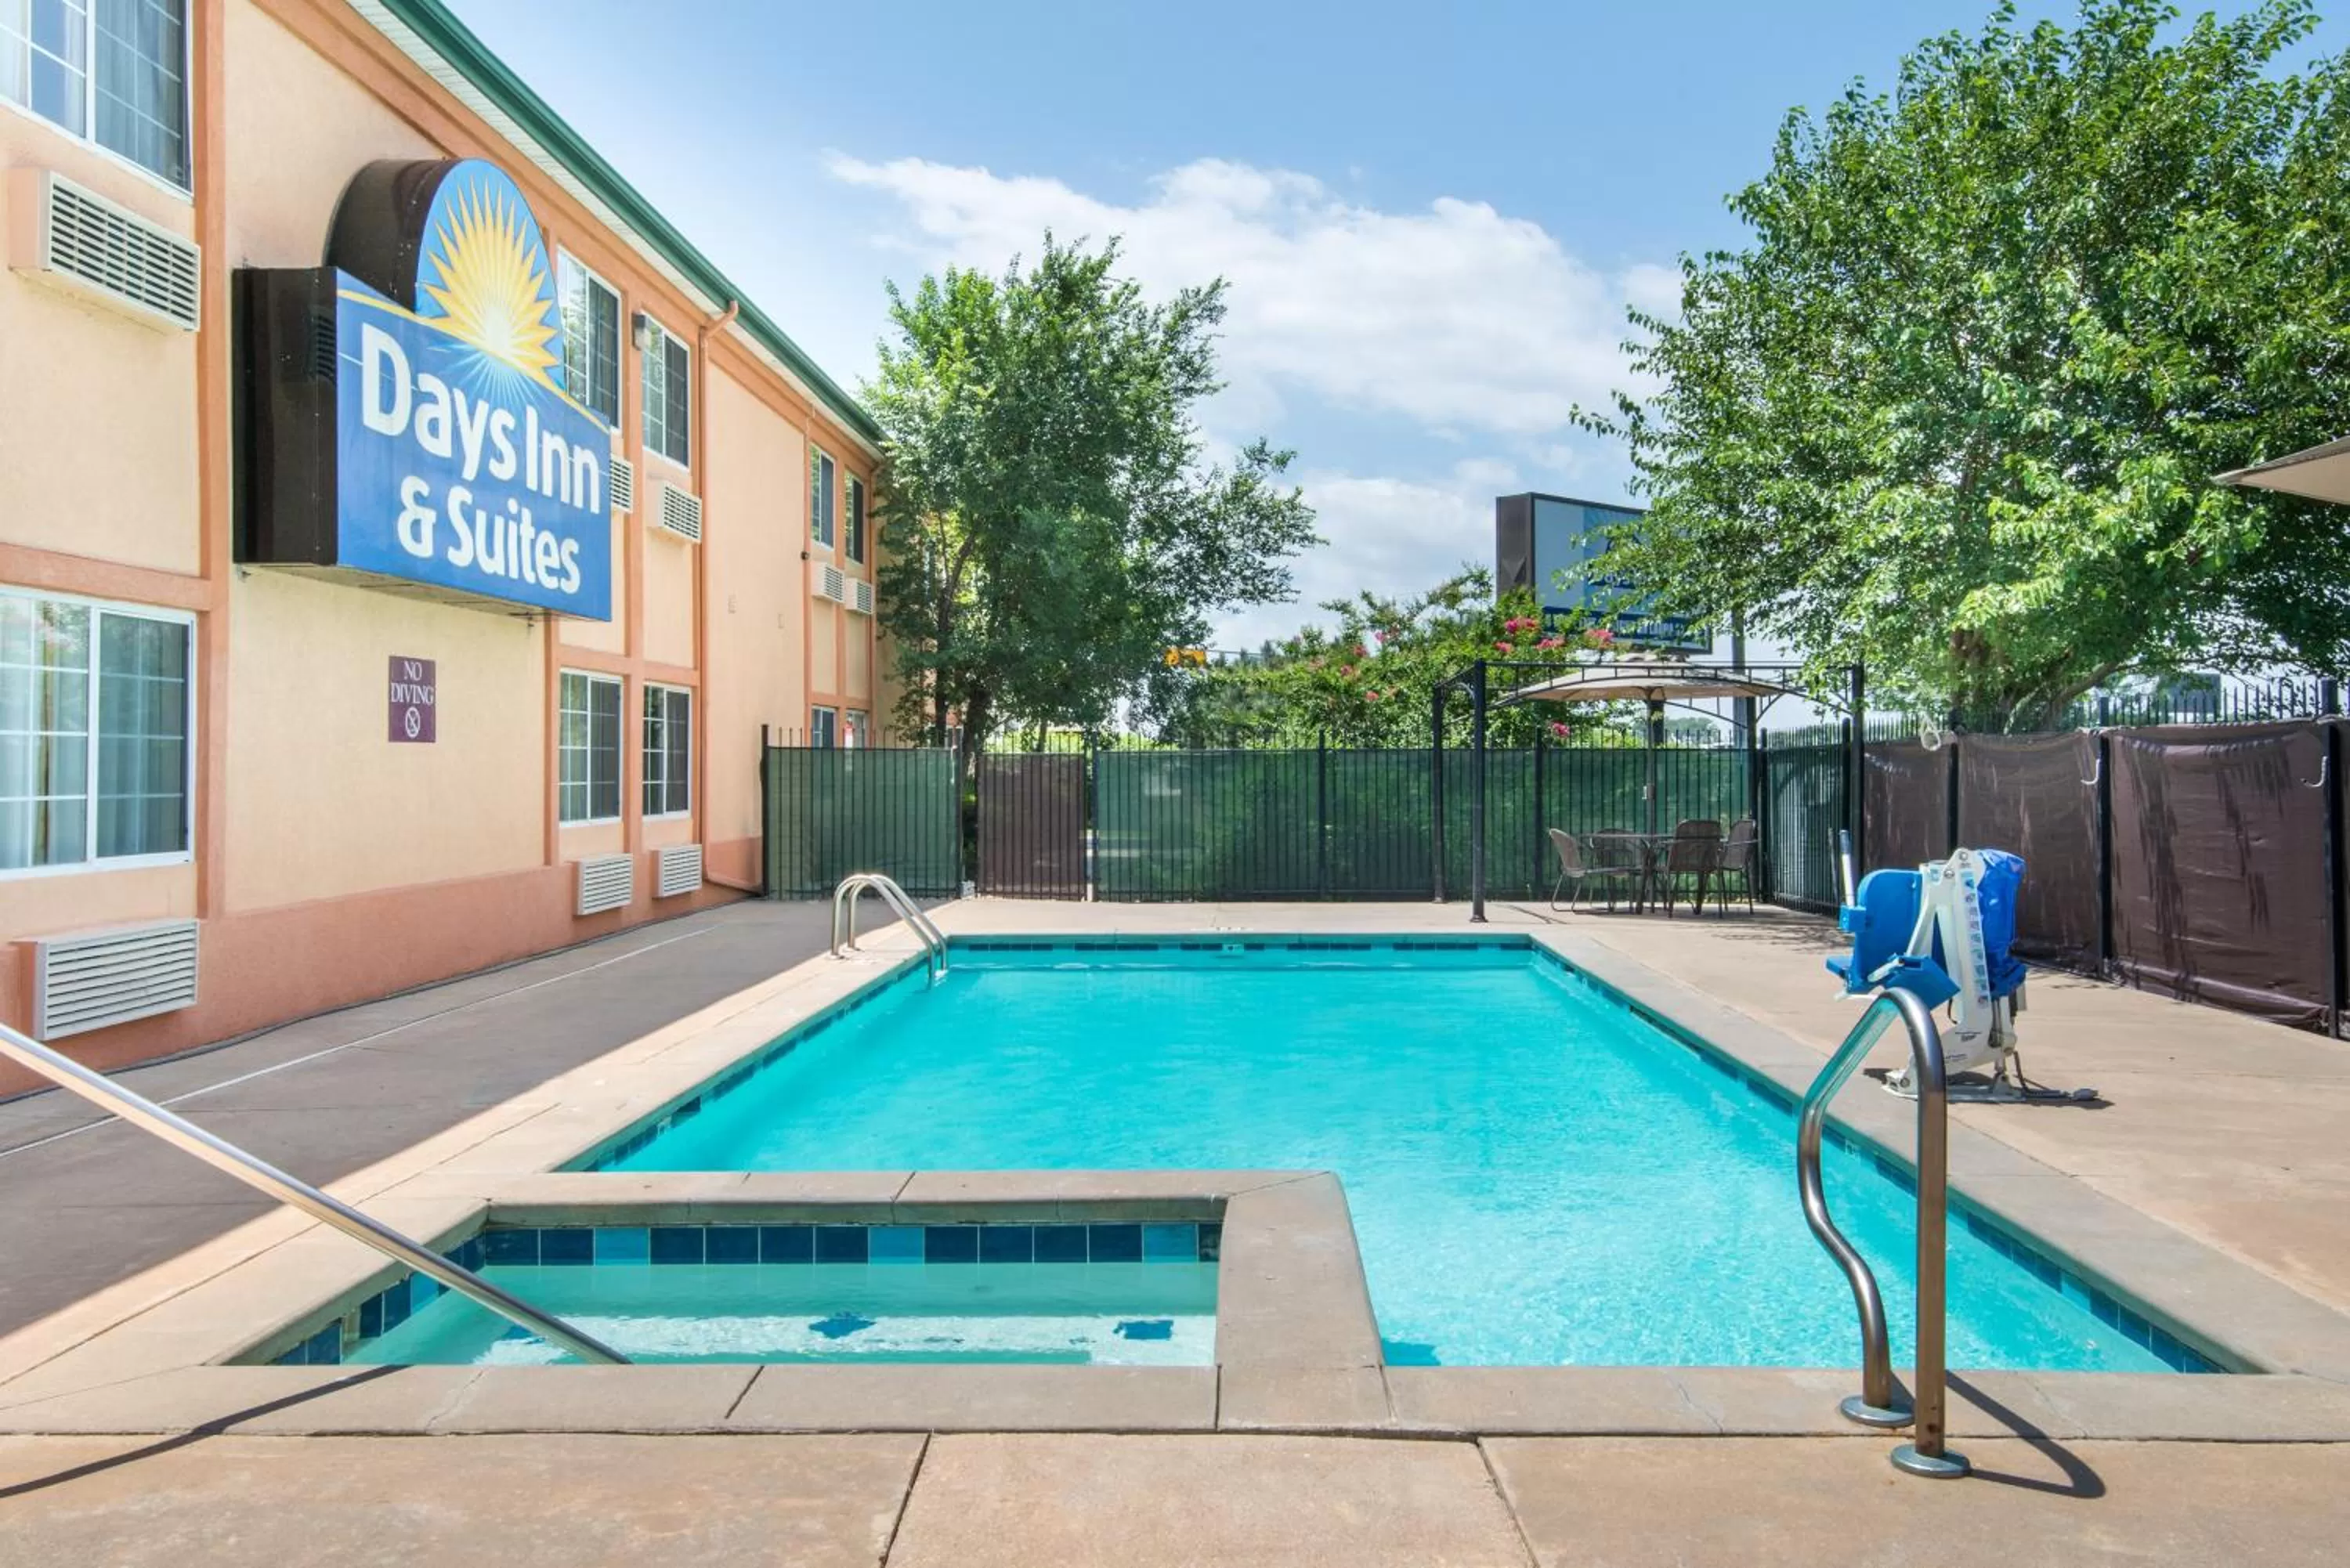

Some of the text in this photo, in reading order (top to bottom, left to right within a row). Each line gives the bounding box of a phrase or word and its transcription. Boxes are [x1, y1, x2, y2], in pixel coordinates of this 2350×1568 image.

[363, 322, 600, 515] Days Inn
[397, 475, 580, 594] & Suites
[391, 682, 434, 704] DIVING
[404, 660, 422, 681] NO
